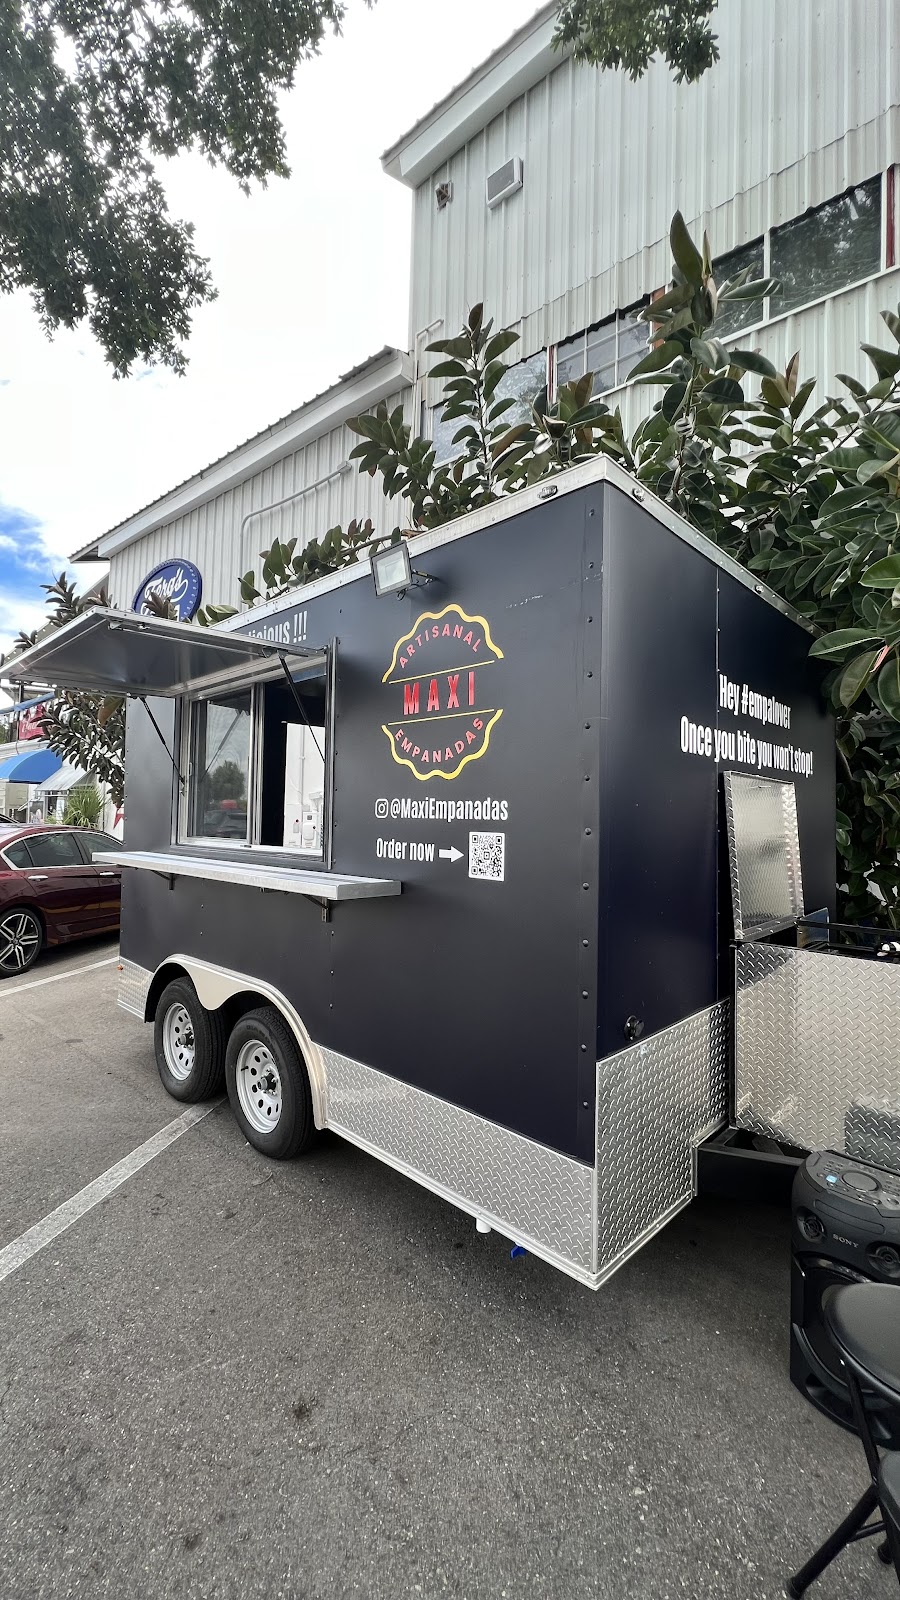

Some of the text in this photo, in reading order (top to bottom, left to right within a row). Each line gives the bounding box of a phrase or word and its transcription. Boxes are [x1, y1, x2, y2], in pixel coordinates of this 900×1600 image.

[399, 623, 482, 668] ARTISANAL
[403, 671, 475, 715] MAXI
[719, 673, 791, 729] Hey #empalover
[394, 717, 484, 763] EMPANADAS
[680, 715, 813, 778] Once you bite you won't stop!
[390, 797, 509, 823] @MaxiEmpanadas
[376, 837, 435, 862] Order now
[832, 1233, 859, 1248] SONY
